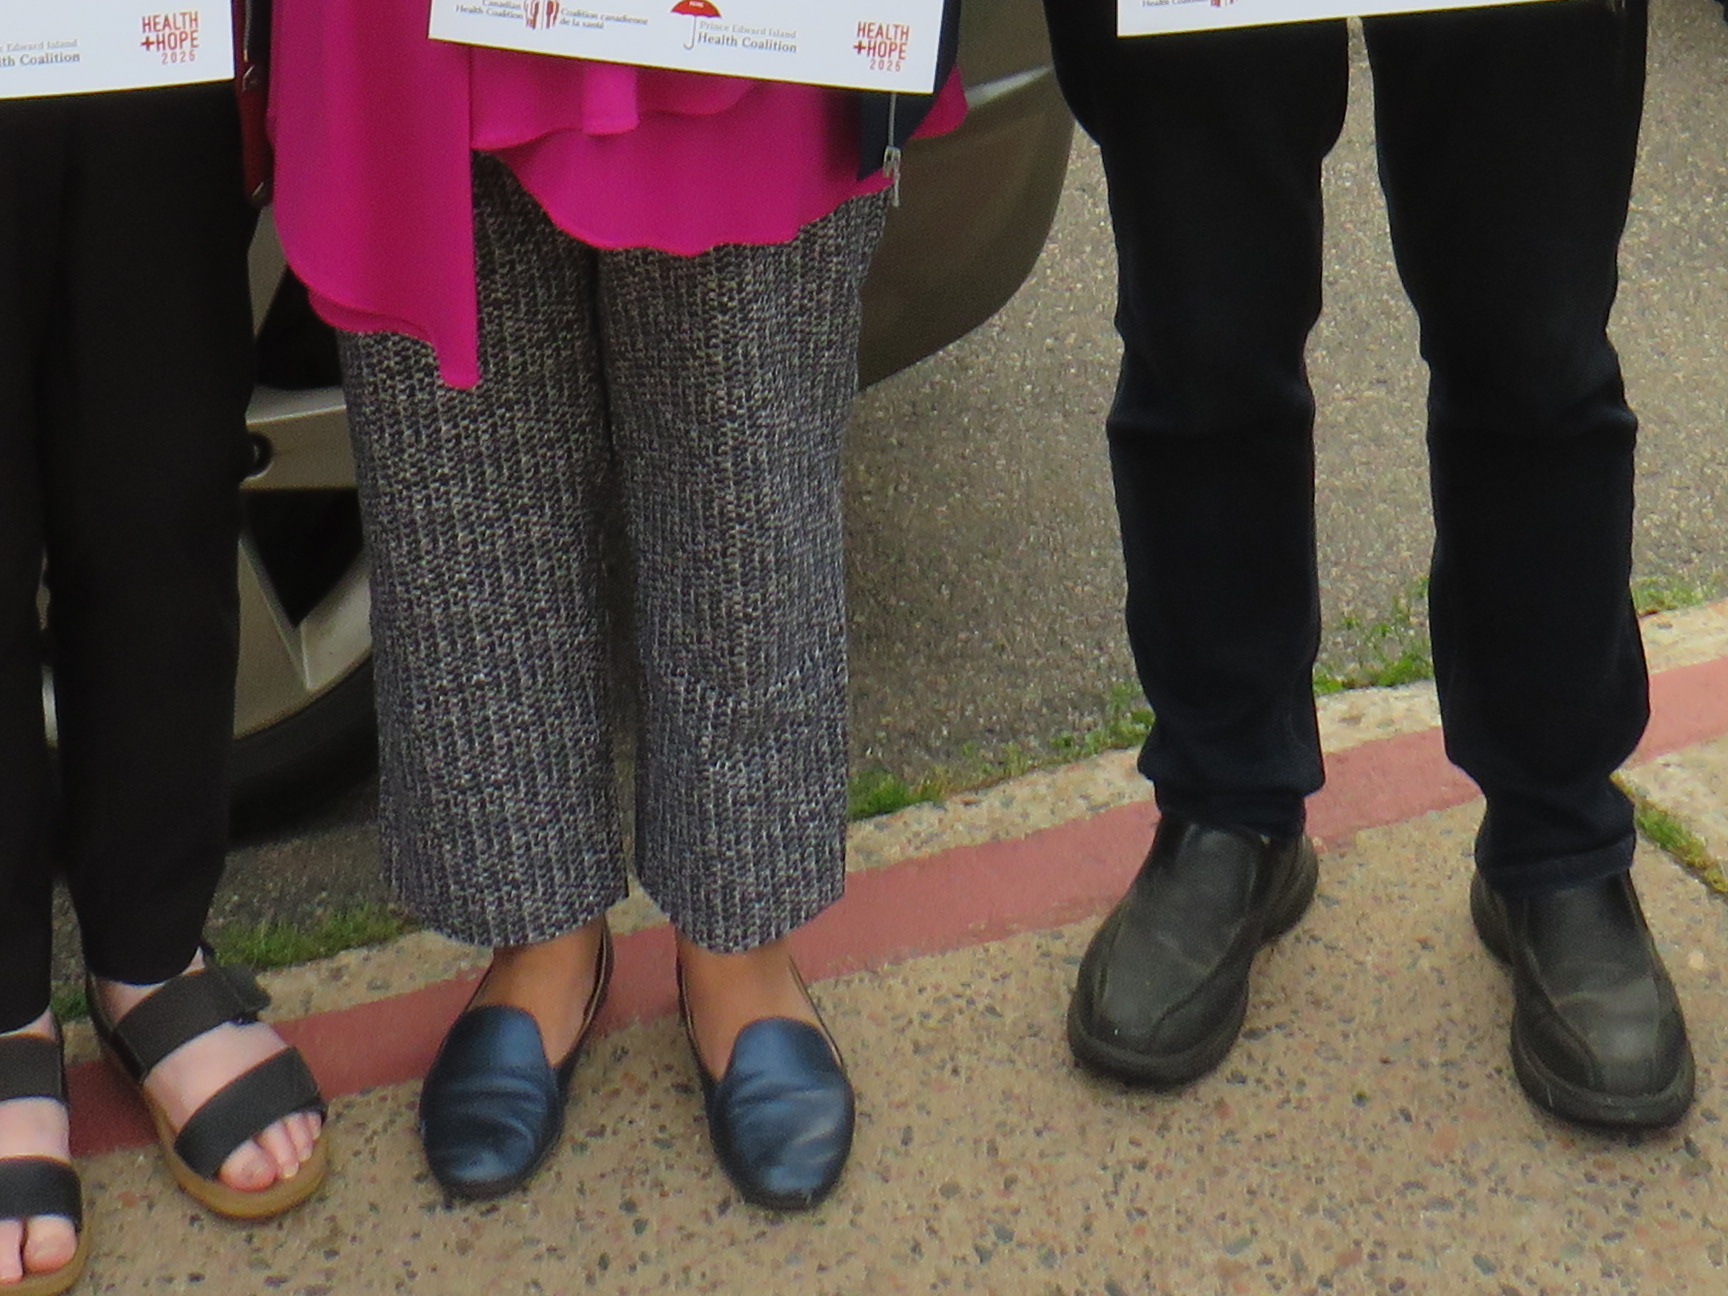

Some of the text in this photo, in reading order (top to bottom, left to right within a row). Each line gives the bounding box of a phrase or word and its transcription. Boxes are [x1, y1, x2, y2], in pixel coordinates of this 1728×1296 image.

[142, 11, 199, 33] HEALTH
[700, 20, 797, 39] Prince Edward Island
[856, 21, 910, 41] HEALTH
[7, 41, 44, 52] Edward
[47, 39, 78, 50] Island
[698, 32, 797, 53] Health Coalition
[22, 52, 80, 66] Coalition
